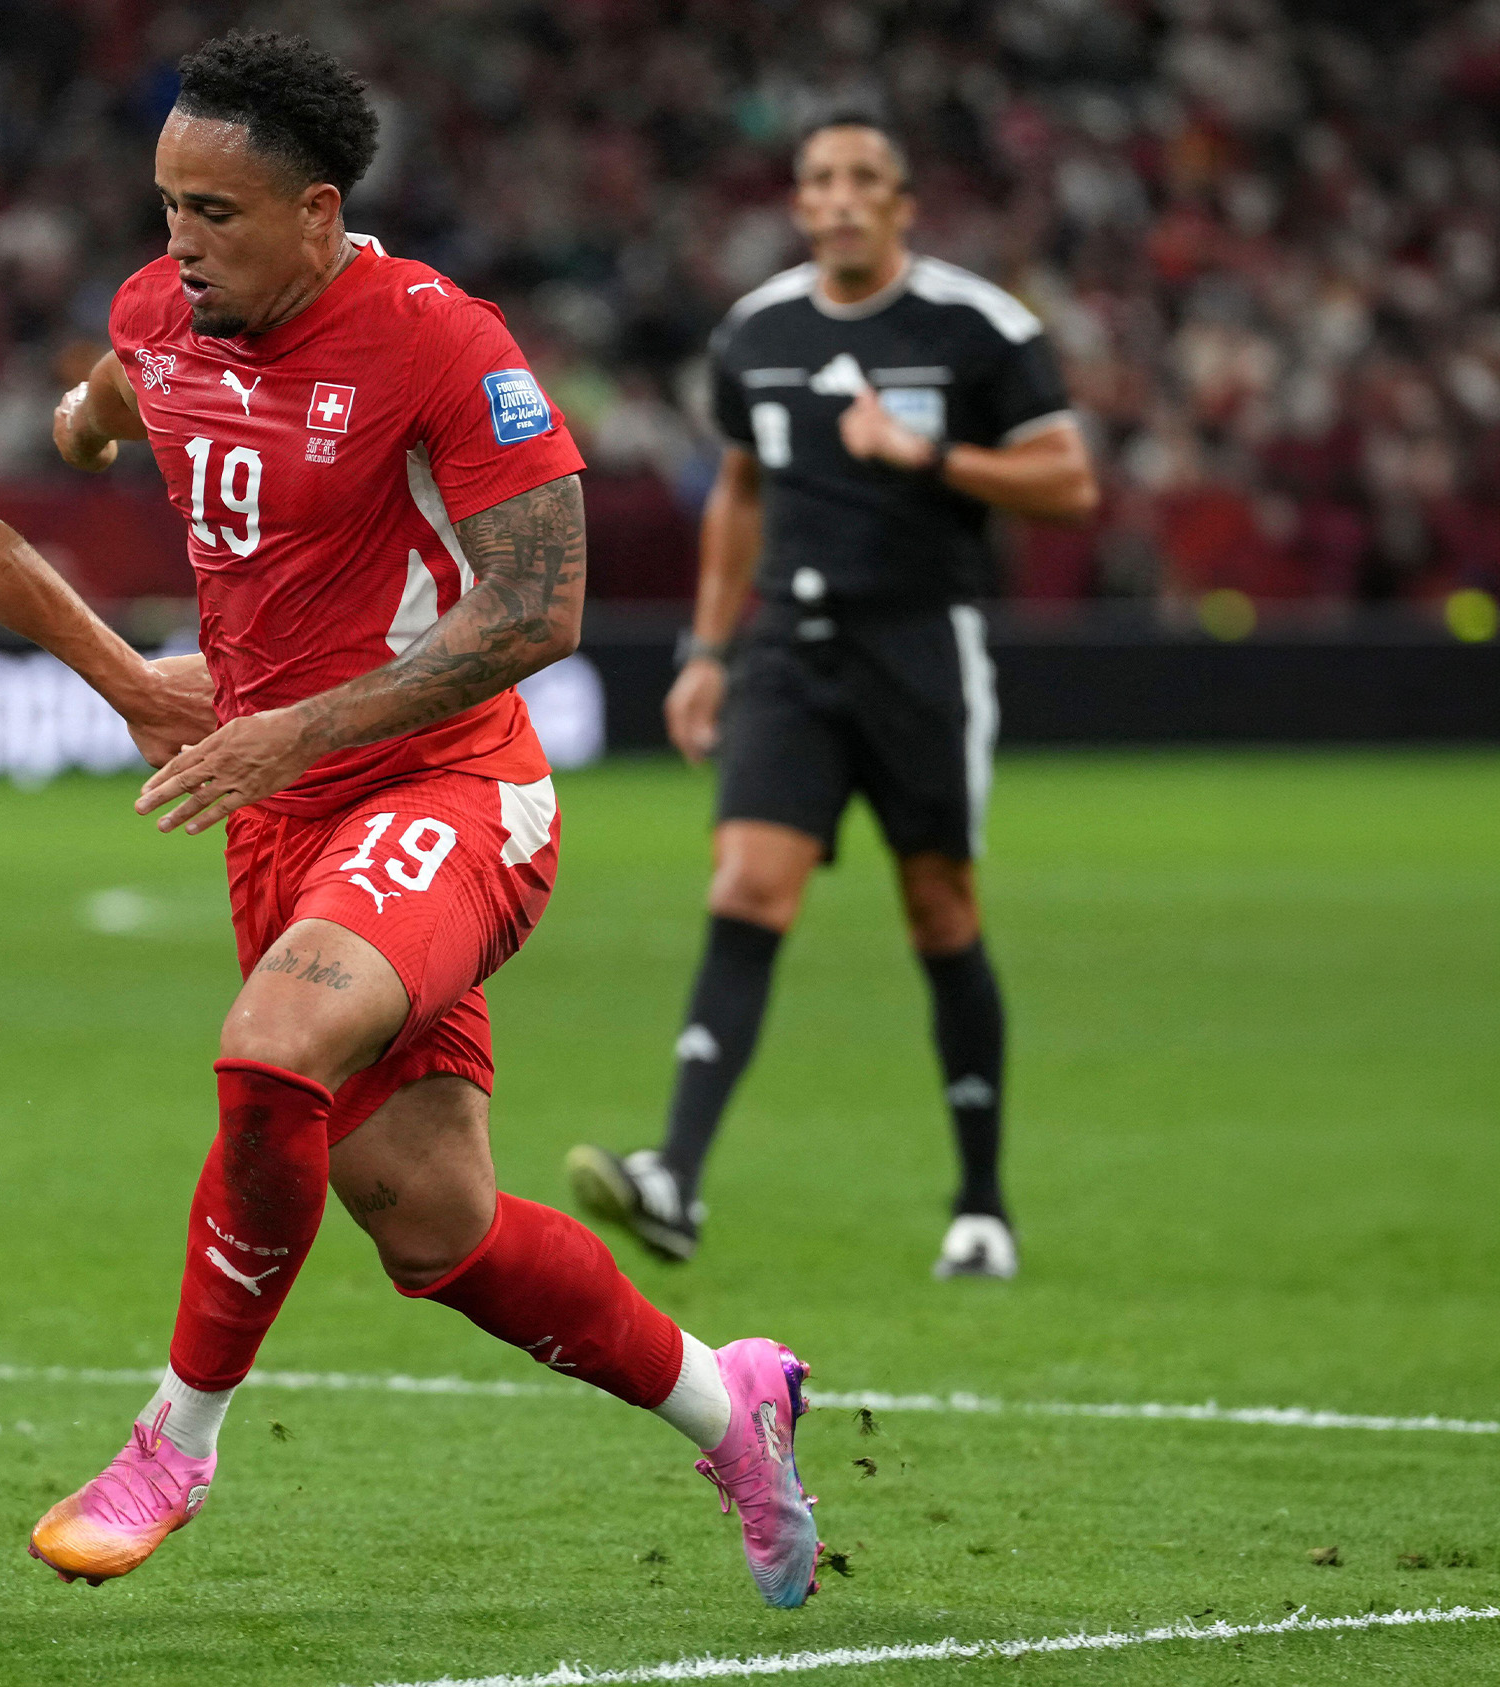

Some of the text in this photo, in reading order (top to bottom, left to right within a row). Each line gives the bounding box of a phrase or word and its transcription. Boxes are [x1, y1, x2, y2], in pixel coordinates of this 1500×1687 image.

[496, 380, 533, 394] FOOTBALL
[499, 390, 538, 409] UNITES
[500, 404, 544, 423] the World
[516, 420, 534, 430] FIFA
[304, 453, 335, 464] VANCOUVER
[184, 436, 263, 557] 19
[338, 811, 459, 892] 19
[750, 1410, 766, 1444] FUTURE
